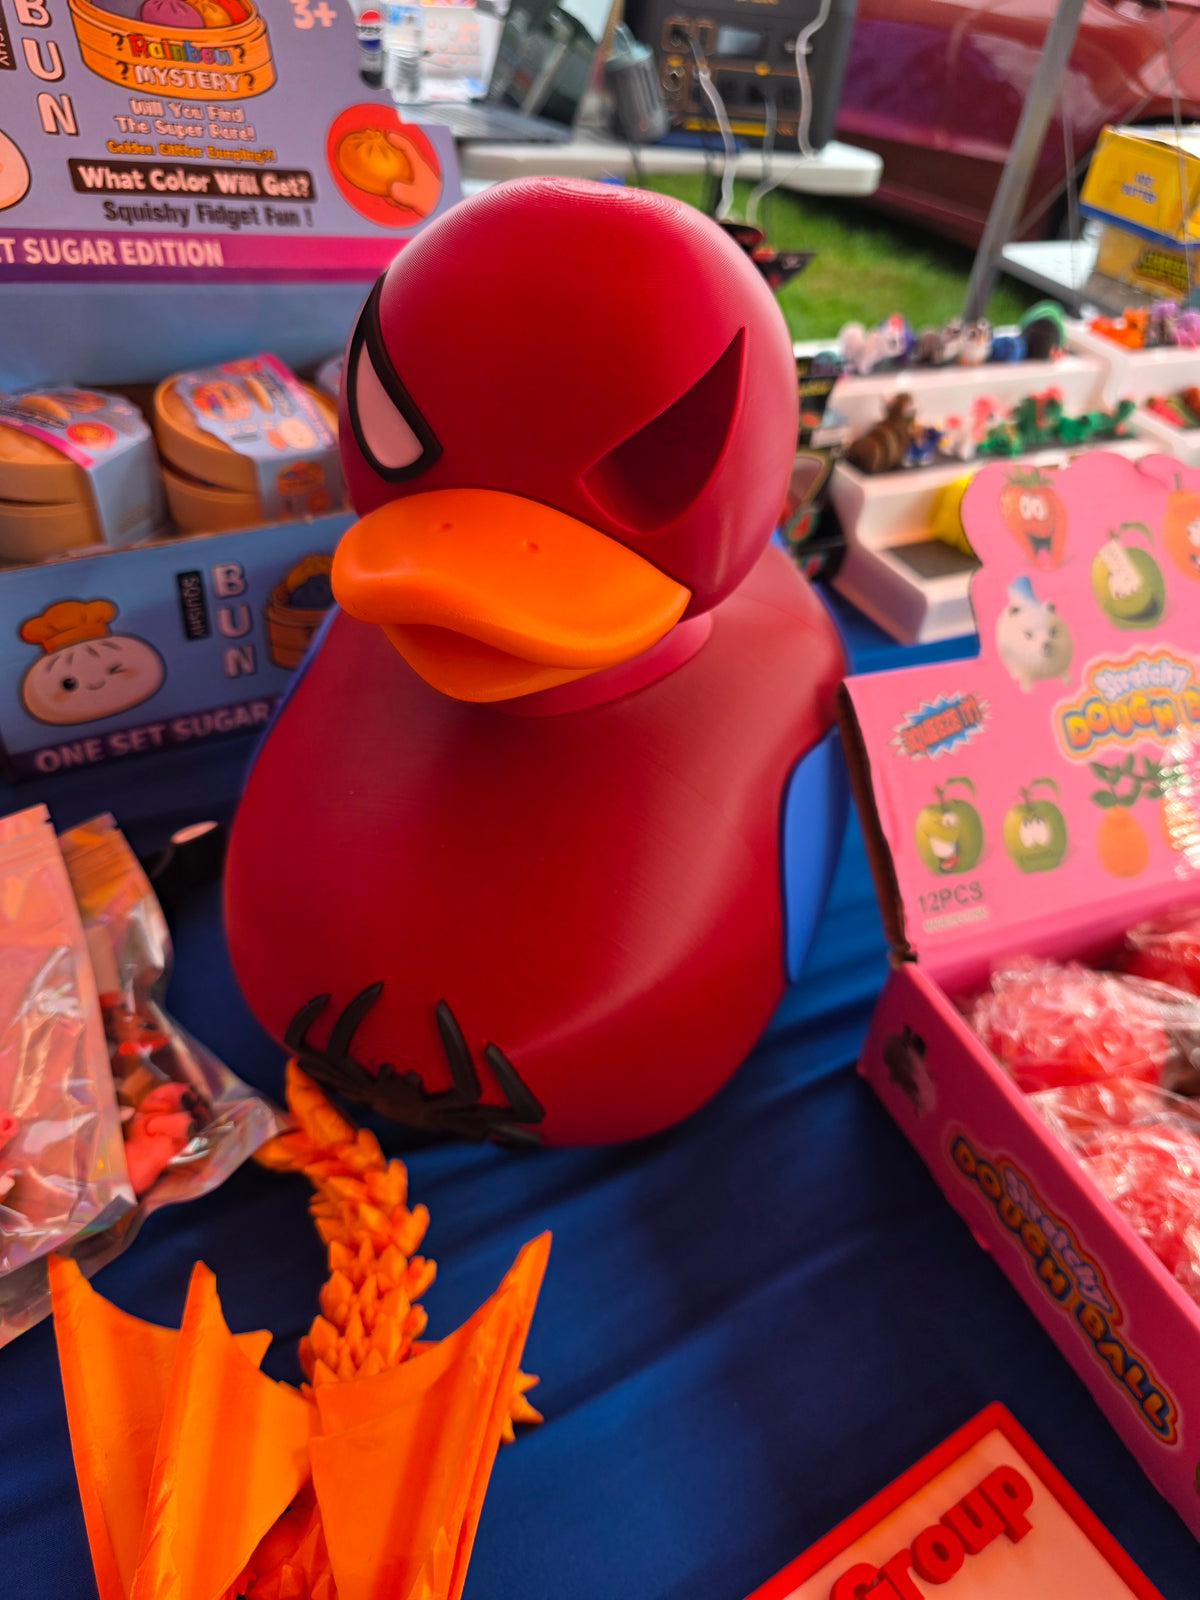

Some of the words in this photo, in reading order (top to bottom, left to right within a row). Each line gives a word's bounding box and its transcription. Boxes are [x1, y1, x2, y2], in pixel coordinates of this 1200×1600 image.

[134, 64, 241, 92] MYSTERY
[114, 115, 150, 134] The
[154, 119, 203, 139] Super
[168, 101, 204, 120] You
[207, 104, 245, 123] Find
[78, 165, 146, 191] What
[150, 168, 210, 193] Color
[212, 171, 261, 196] Will
[262, 175, 310, 198] Get?
[103, 201, 191, 228] Squishy
[197, 203, 262, 231] Fidget
[22, 237, 118, 265] SUGAR
[118, 238, 224, 267] EDITION
[34, 738, 103, 773] ONE
[108, 724, 167, 755] SET
[171, 701, 270, 741] SUGAR
[917, 880, 984, 916] 12PCS
[952, 1135, 1072, 1301] DOUGH
[1075, 1302, 1170, 1436] BALL
